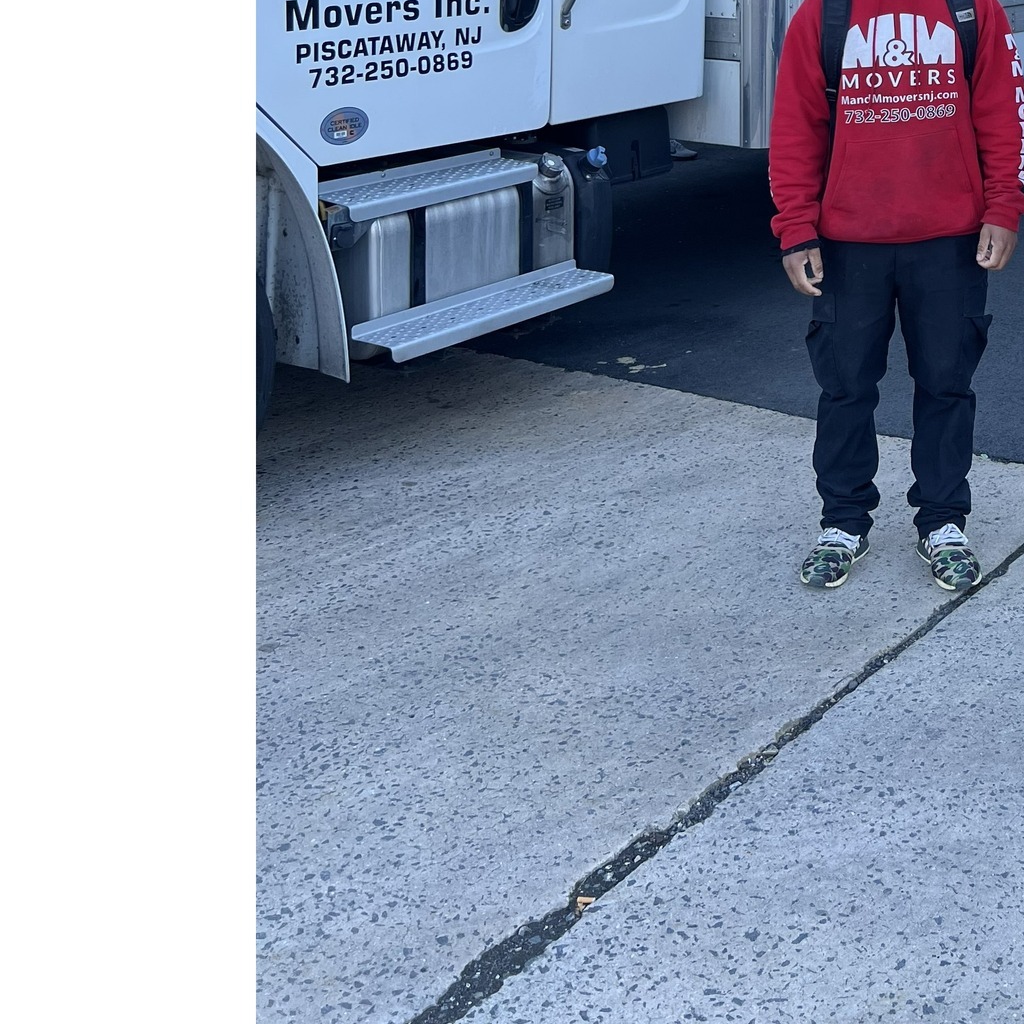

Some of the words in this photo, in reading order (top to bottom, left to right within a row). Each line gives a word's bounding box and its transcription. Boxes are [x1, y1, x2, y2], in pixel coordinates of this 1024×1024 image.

[296, 30, 446, 64] PISCATAWAY,
[455, 26, 482, 46] NJ
[309, 51, 473, 88] 732-250-0869
[842, 69, 956, 90] MOVERS
[844, 104, 956, 124] 732-250-0869
